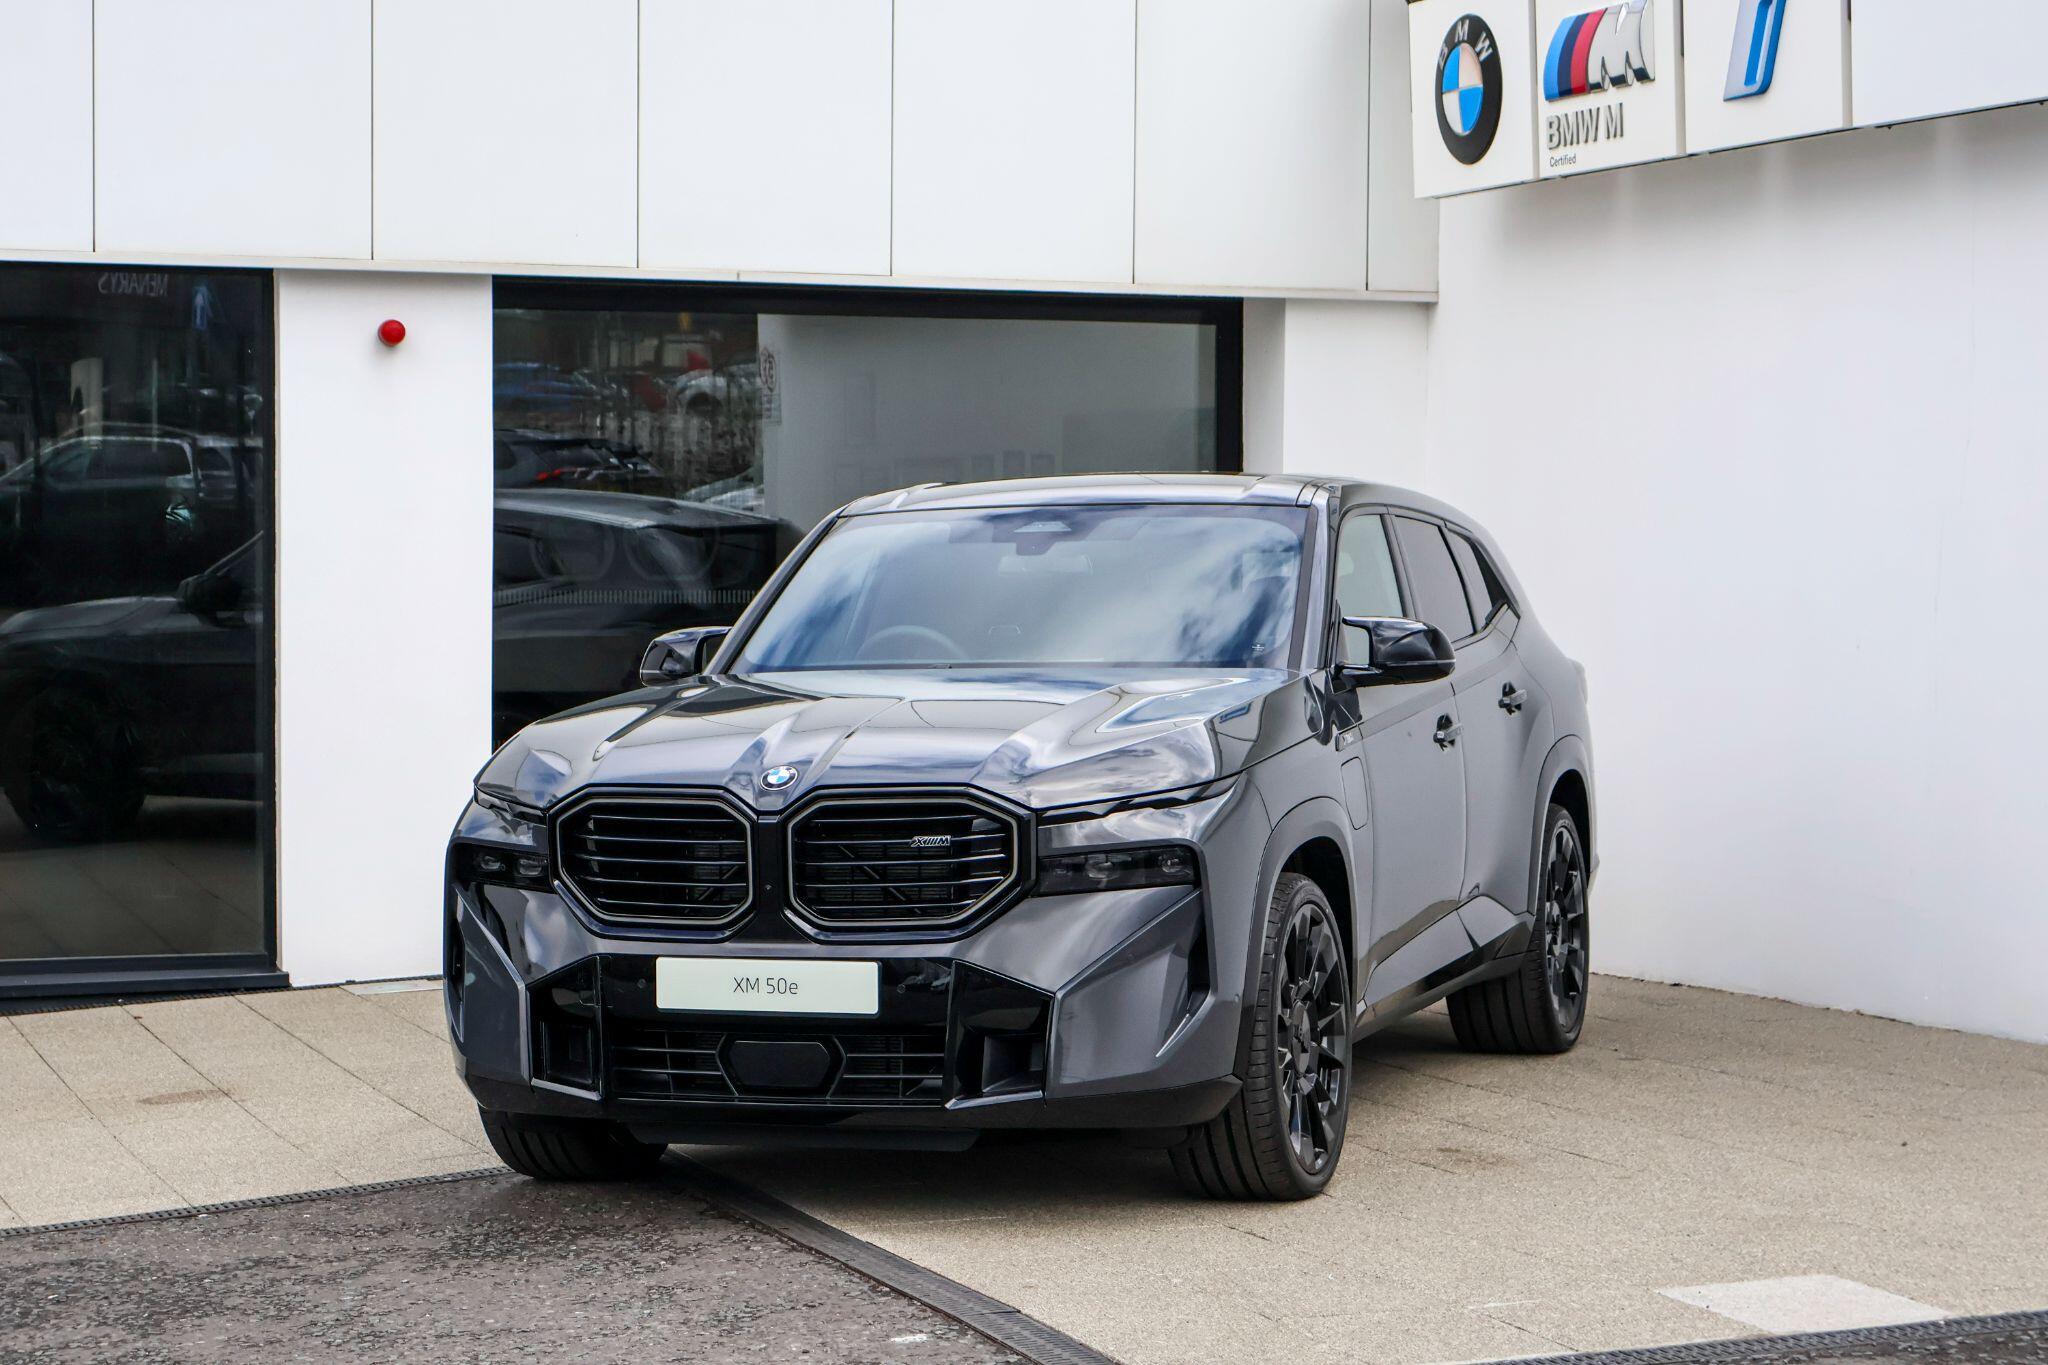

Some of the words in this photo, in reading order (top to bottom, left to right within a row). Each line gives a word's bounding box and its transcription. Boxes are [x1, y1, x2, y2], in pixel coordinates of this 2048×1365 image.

[1438, 19, 1494, 71] BMW
[1546, 107, 1600, 150] BMW
[1603, 102, 1624, 140] M
[1549, 153, 1577, 168] Certified
[733, 977, 760, 994] XM
[766, 977, 799, 995] 50e
